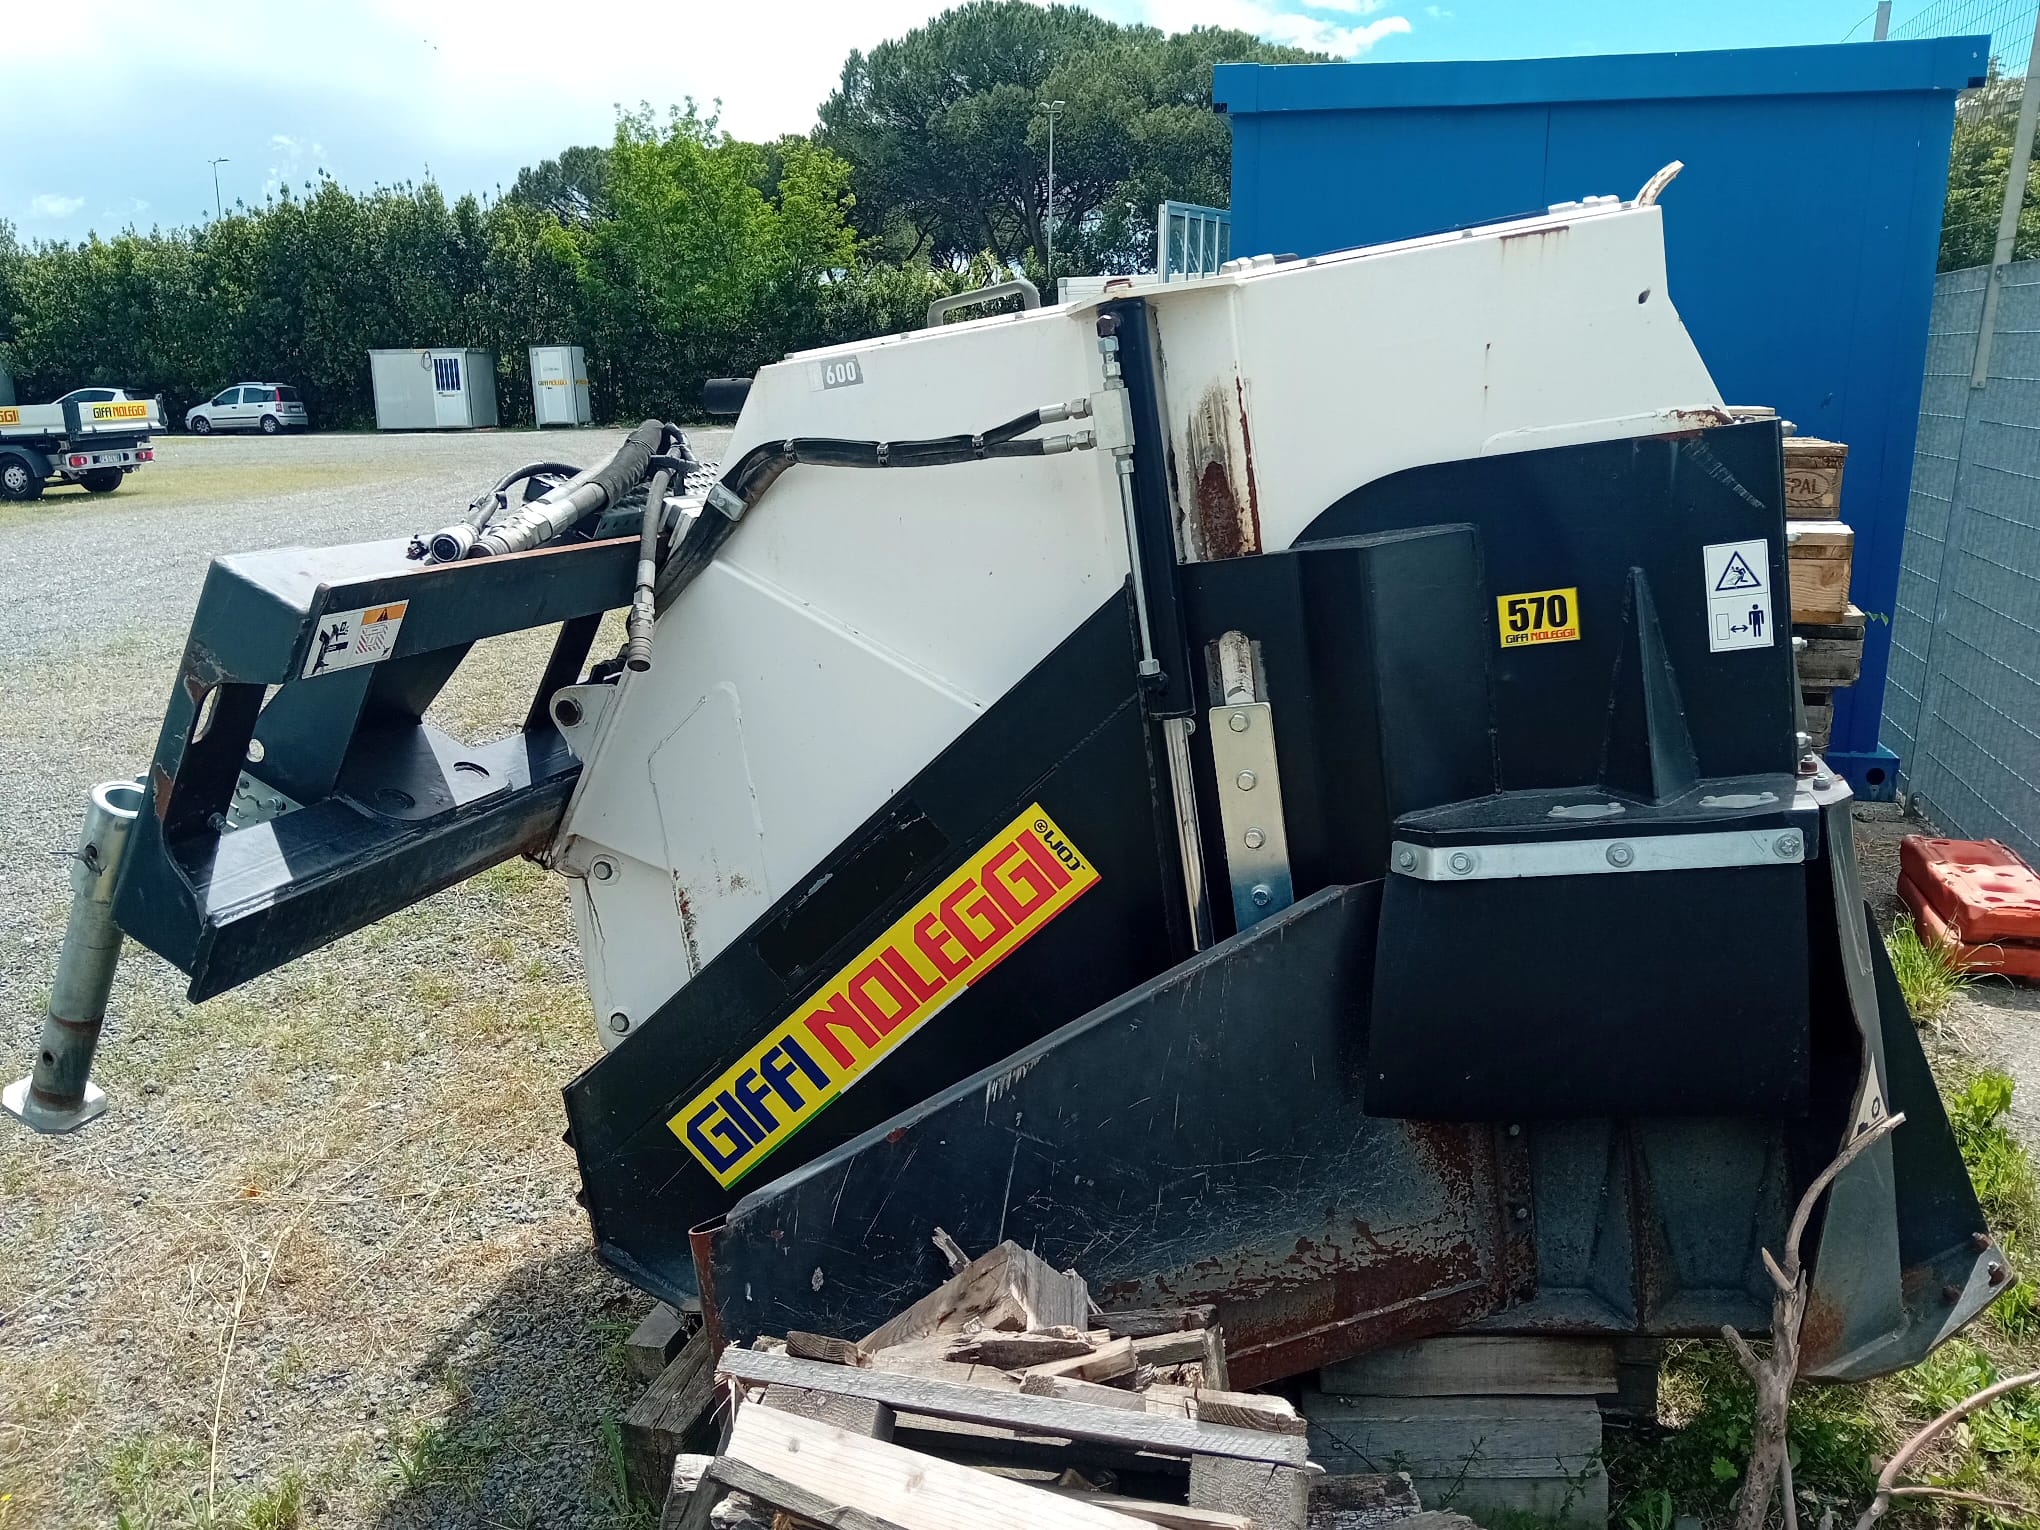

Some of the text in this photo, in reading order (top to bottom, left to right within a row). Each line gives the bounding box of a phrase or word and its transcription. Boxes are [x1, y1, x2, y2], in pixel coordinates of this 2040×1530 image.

[826, 361, 857, 385] 600
[93, 407, 112, 418] GIFFI
[1507, 594, 1568, 632] 570
[1505, 634, 1529, 644] GIFFI
[686, 828, 1074, 1175] GIFFI NOLEGGI
